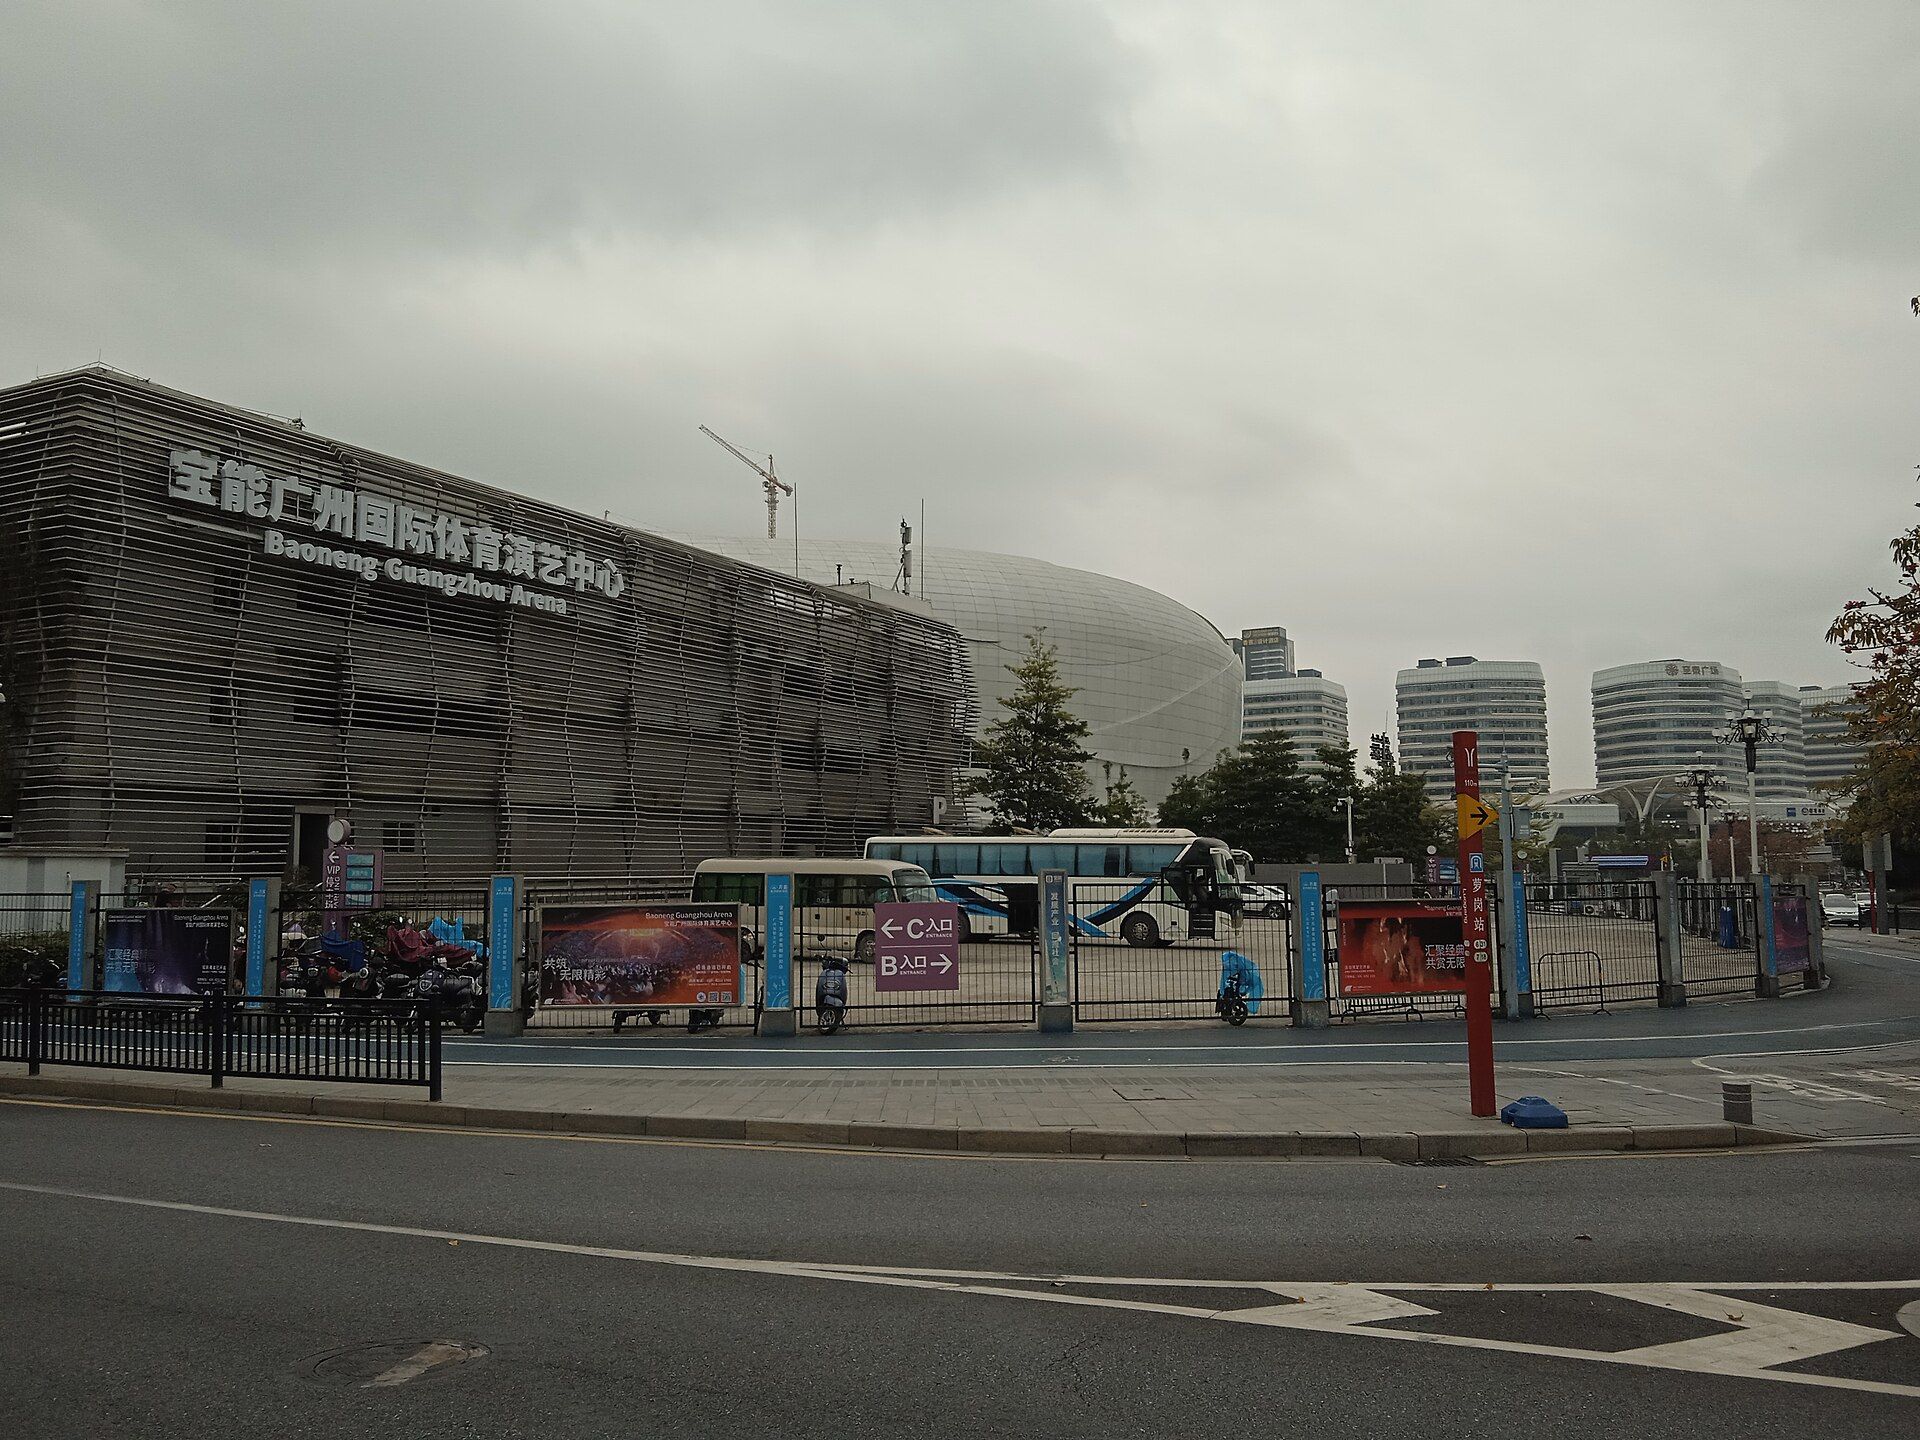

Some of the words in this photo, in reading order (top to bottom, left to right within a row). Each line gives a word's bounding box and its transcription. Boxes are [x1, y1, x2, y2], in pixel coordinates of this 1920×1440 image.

[169, 449, 625, 598] 宝能广州国际体育演艺中心
[264, 530, 379, 581] Baoneng
[384, 557, 507, 602] Guangzhou
[509, 585, 567, 616] Arena
[933, 796, 947, 824] P
[327, 865, 341, 875] VIP
[1472, 877, 1486, 932] 萝岗站
[645, 912, 675, 920] Baoneng
[675, 911, 712, 920] Guangzhou
[907, 918, 924, 939] C
[926, 917, 953, 932] 入口
[1425, 943, 1465, 957] 汇聚经典
[542, 957, 568, 970] 共筑
[881, 955, 898, 976] B
[899, 954, 927, 969] 入口
[1425, 957, 1466, 970] 共赏无限
[559, 968, 606, 982] 无限精彩
